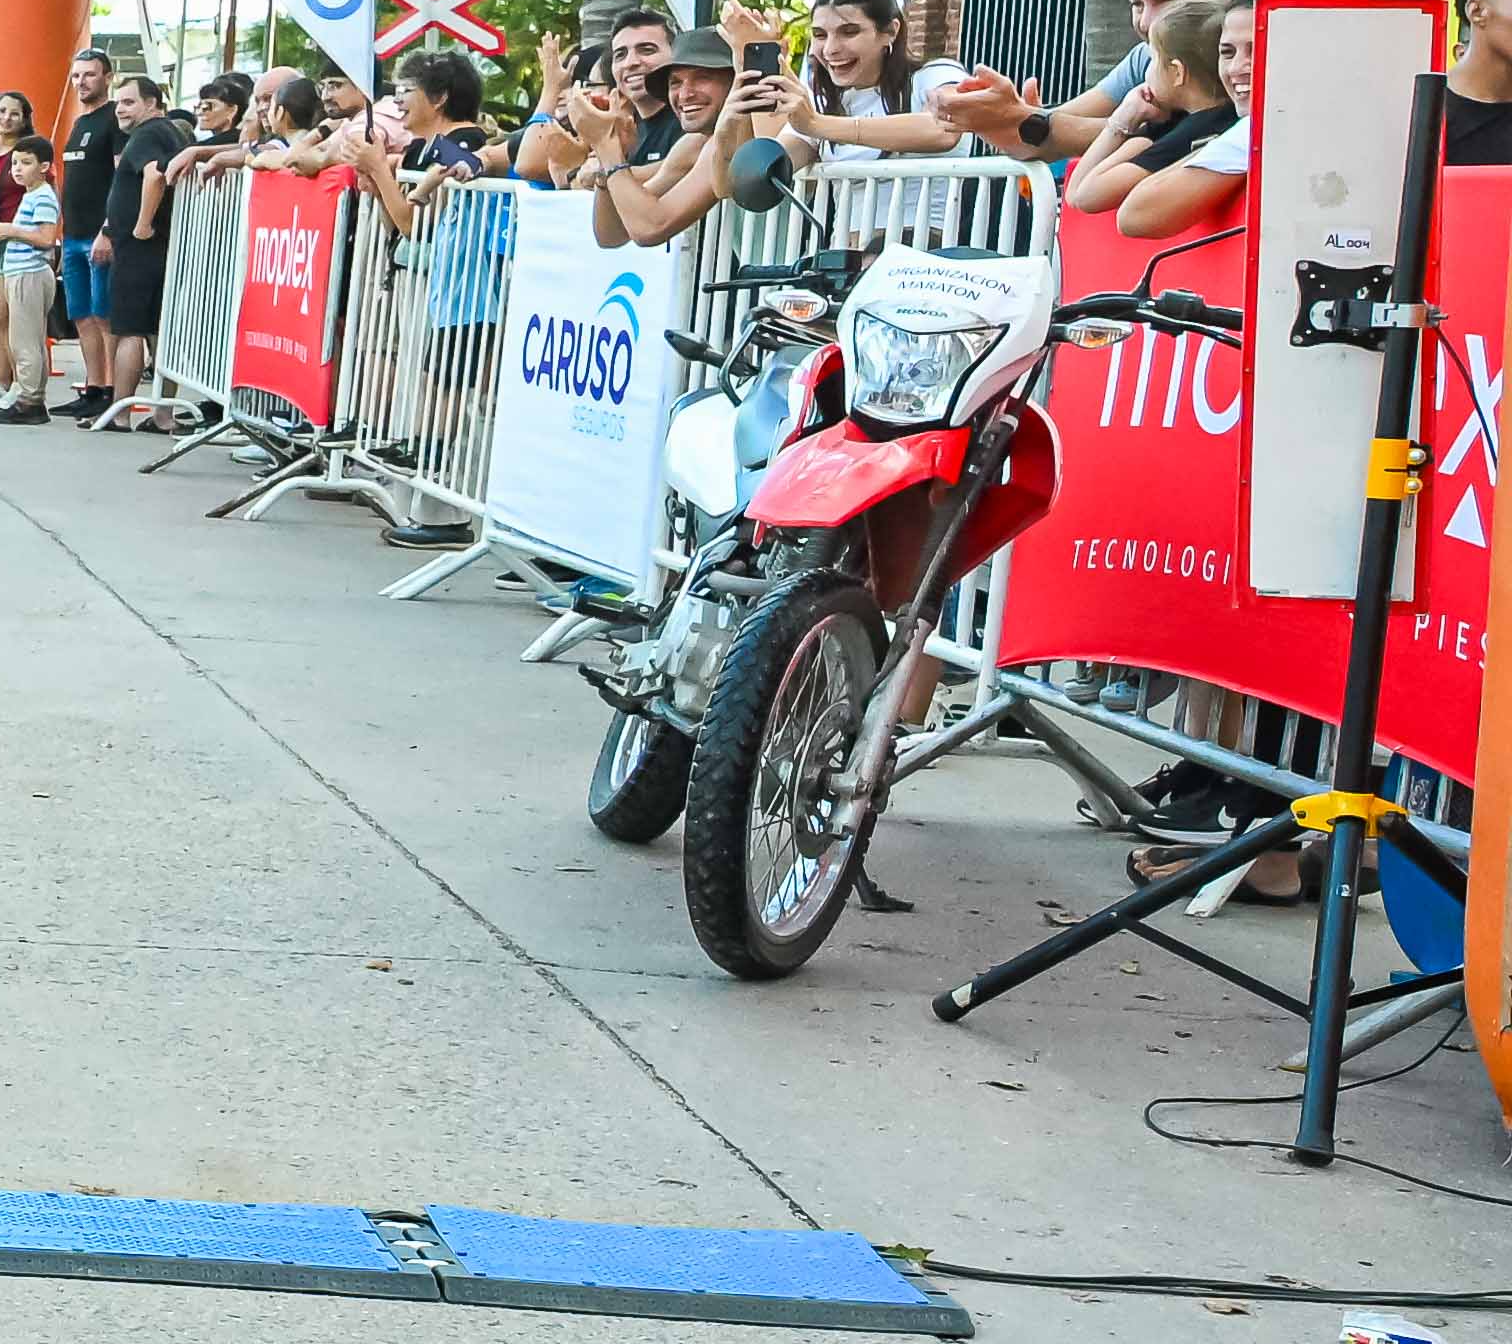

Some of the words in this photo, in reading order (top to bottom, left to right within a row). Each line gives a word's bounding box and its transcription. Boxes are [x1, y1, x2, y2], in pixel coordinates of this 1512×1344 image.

[252, 205, 320, 307] moplex
[888, 264, 1012, 295] ORGANIZACION
[897, 280, 982, 301] MARATON
[895, 308, 949, 319] HONDA
[522, 314, 633, 405] CARUSO
[1072, 539, 1232, 586] TECNOLOGI
